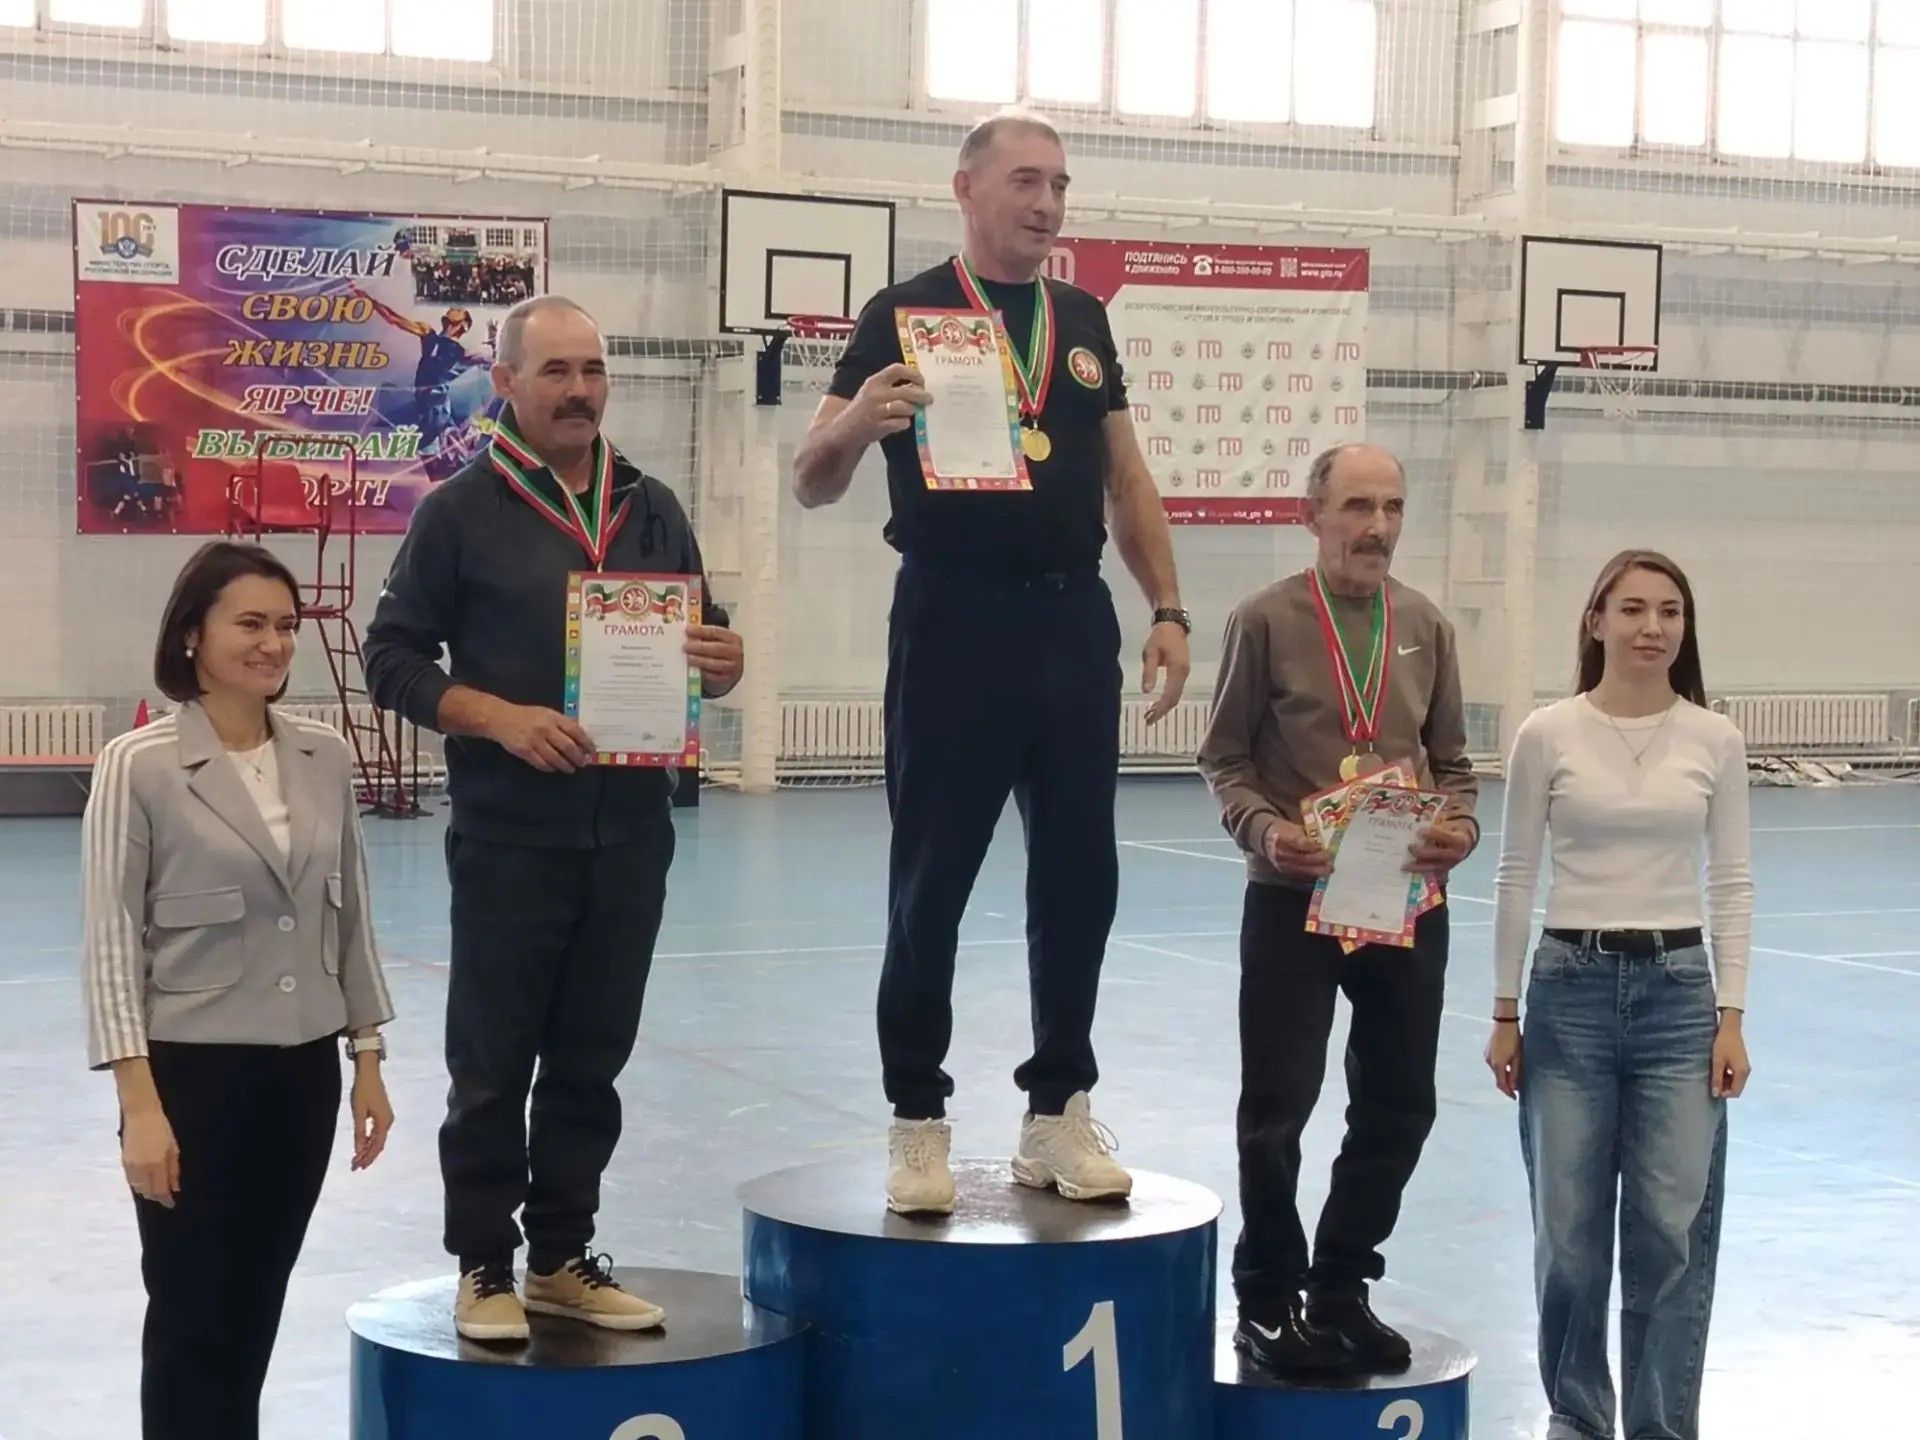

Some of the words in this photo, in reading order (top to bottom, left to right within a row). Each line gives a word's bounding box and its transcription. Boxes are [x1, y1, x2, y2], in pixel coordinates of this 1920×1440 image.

[216, 244, 399, 281] СДЕЛАЙ
[242, 292, 375, 324] СВОЮ
[222, 338, 390, 369] ЖИЗНЬ
[935, 355, 984, 367] ГРАМОТА
[236, 384, 376, 415] ЯРЧЕ!
[192, 424, 422, 460] ВЫБИРАЙ
[604, 624, 665, 636] ГРАМОТА
[1368, 817, 1412, 831] ГРАМОТА
[1063, 1300, 1123, 1440] 1
